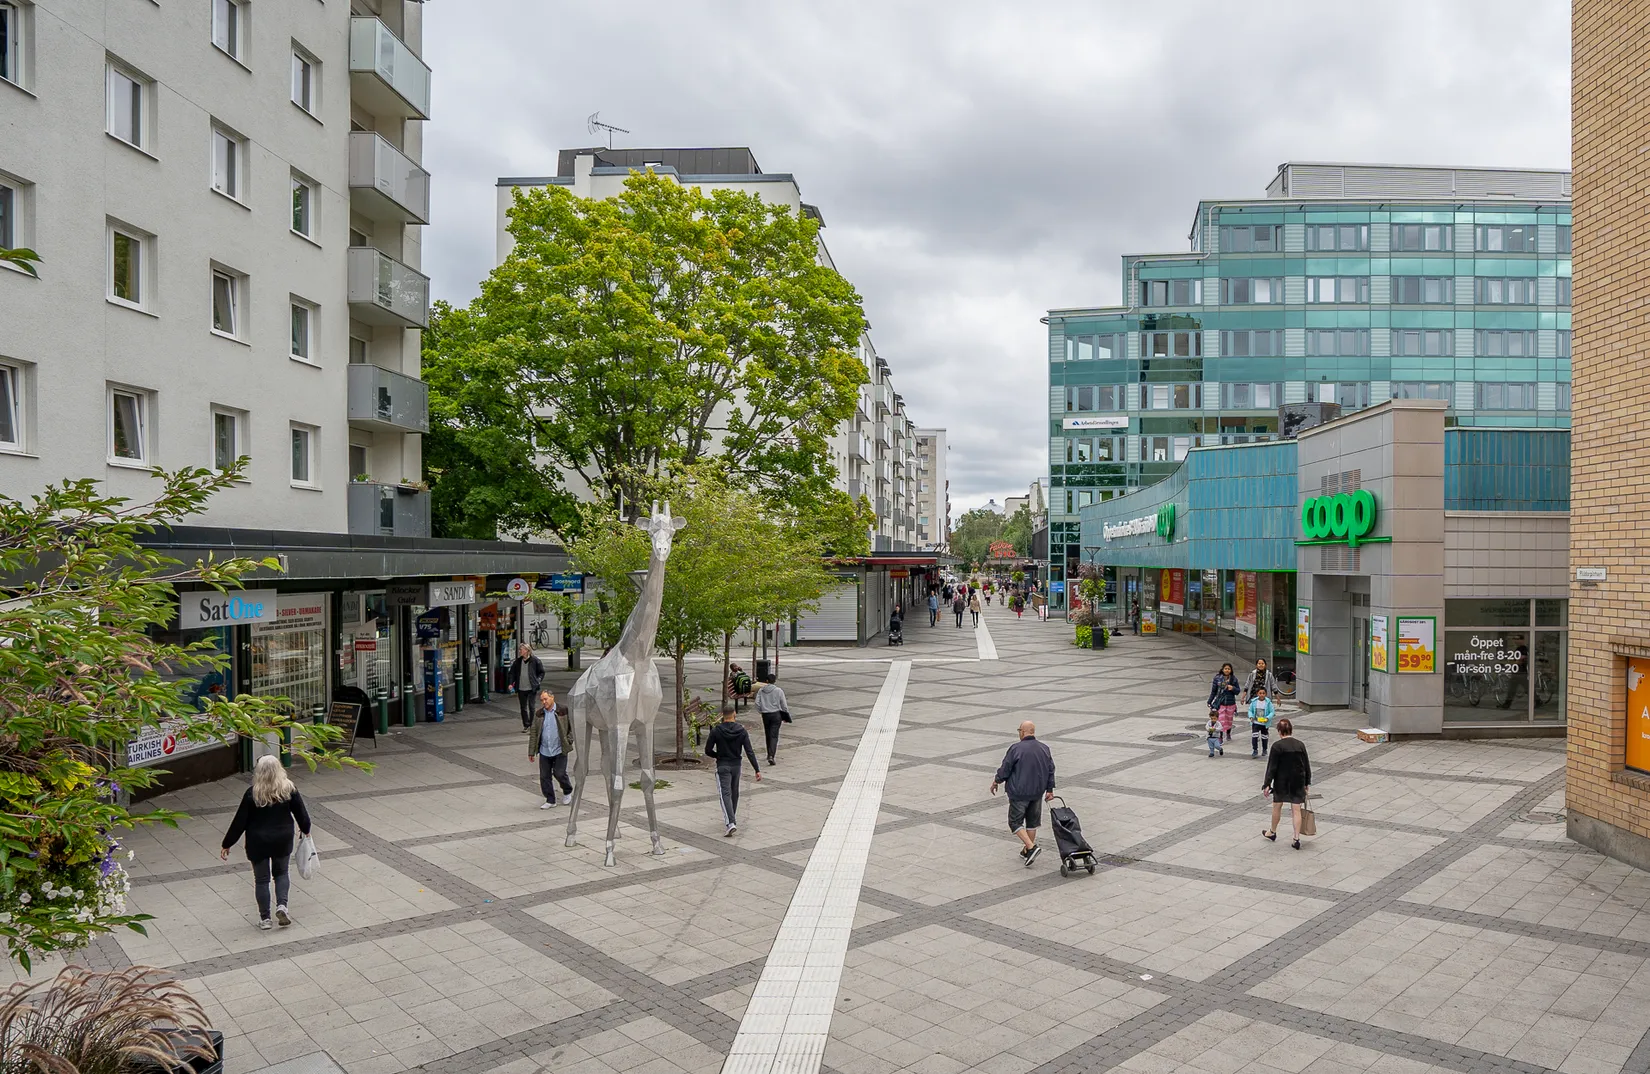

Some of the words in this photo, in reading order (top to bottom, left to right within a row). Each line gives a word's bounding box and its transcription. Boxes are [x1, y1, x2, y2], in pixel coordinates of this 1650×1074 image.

[1302, 489, 1376, 547] coop
[994, 550, 1016, 558] BIO
[443, 587, 466, 601] SANDI
[200, 596, 264, 622] SatOne
[1470, 635, 1504, 649] Öppet
[1454, 650, 1495, 661] mån-fre
[1497, 651, 1522, 661] 8-20
[1456, 663, 1492, 674] lör-sön
[1494, 663, 1519, 674] 9-20
[127, 739, 162, 754] TURKISH
[127, 748, 162, 763] AIRLINES
